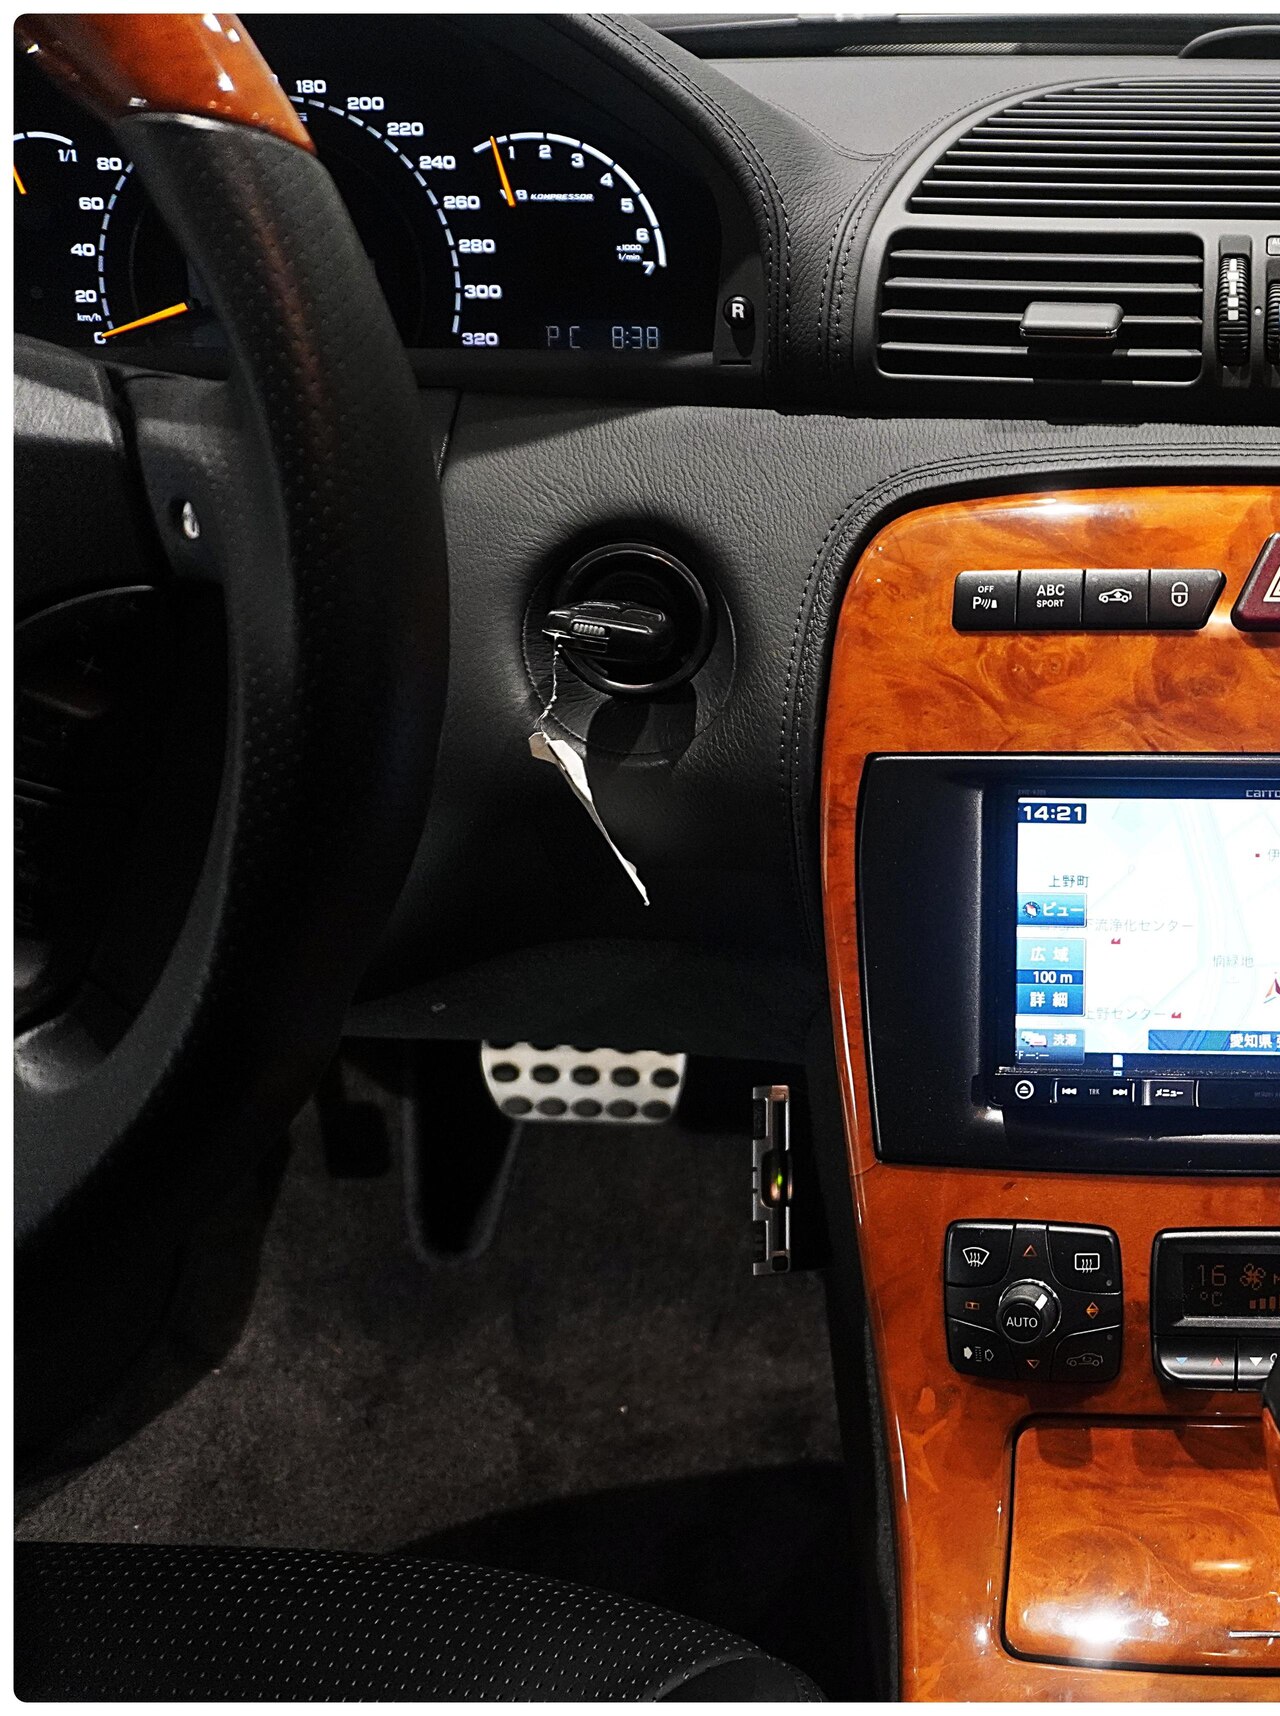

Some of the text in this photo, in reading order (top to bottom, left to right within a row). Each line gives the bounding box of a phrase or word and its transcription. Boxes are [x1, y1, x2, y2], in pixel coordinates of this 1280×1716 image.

[295, 79, 327, 94] 180
[347, 96, 384, 111] 200
[386, 121, 424, 136] 220
[58, 149, 77, 162] 1/1
[508, 145, 516, 159] 1
[539, 145, 551, 159] 2
[96, 157, 122, 171] 80
[419, 155, 456, 170] 240
[572, 153, 584, 167] 3
[600, 172, 614, 187] 4
[79, 197, 104, 211] 60
[443, 195, 480, 209] 260
[530, 193, 594, 201] KOMPRESSOR
[620, 198, 634, 213] 5
[636, 228, 649, 243] 6
[71, 243, 95, 257] 40
[458, 239, 495, 253] 280
[643, 261, 655, 275] 7
[75, 289, 97, 303] 20
[464, 284, 501, 299] 300
[77, 312, 101, 322] km/h
[732, 303, 743, 317] R
[461, 332, 498, 346] 320
[612, 326, 659, 349] 8:38
[977, 585, 994, 594] OFF
[1036, 584, 1065, 597] ABC
[1036, 599, 1065, 608] SPORT
[1023, 806, 1084, 822] 14:21
[1048, 874, 1090, 889] 上野町
[1042, 902, 1084, 917] ビュー
[1030, 947, 1069, 962] 広域
[1033, 970, 1073, 983] 100 m
[1030, 991, 1068, 1009] 詳細
[1229, 1032, 1273, 1050] 愛知県
[1155, 1088, 1184, 1098] メニュー
[1198, 1264, 1227, 1287] 16
[1006, 1316, 1038, 1328] AUTO
